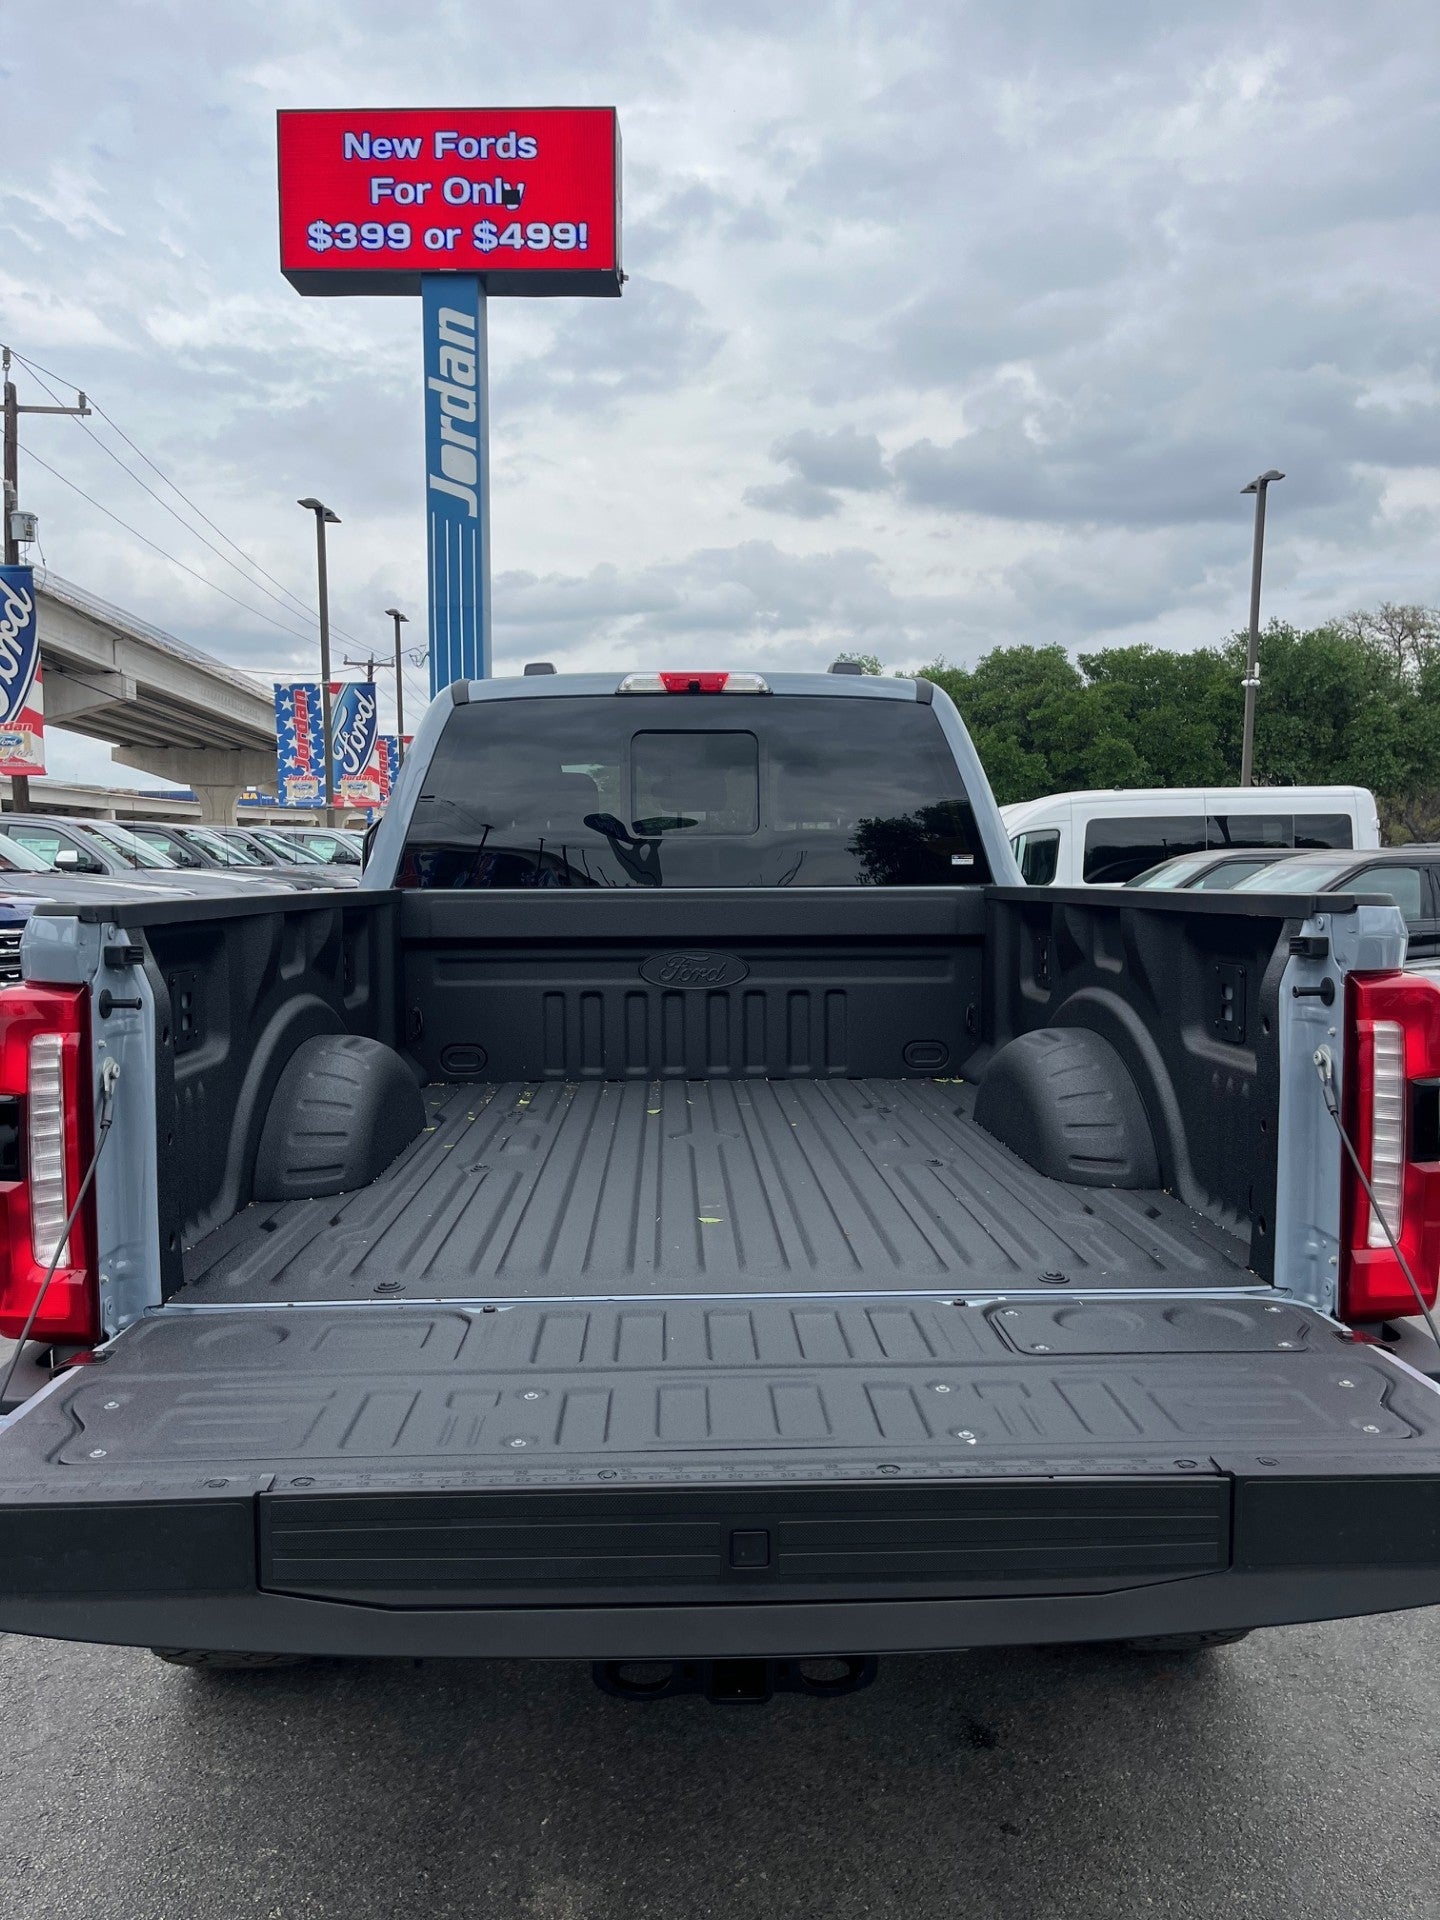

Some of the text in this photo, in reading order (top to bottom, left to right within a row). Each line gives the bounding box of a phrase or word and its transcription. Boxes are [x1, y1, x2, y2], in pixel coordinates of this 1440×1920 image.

[343, 130, 538, 160] New Fords
[370, 177, 431, 205] For
[307, 220, 588, 252] $399 or $499!
[428, 307, 478, 518] Jordan
[0, 577, 33, 718] ord
[292, 689, 311, 773] Jordan
[332, 689, 375, 773] Ford
[659, 955, 727, 983] Ford
